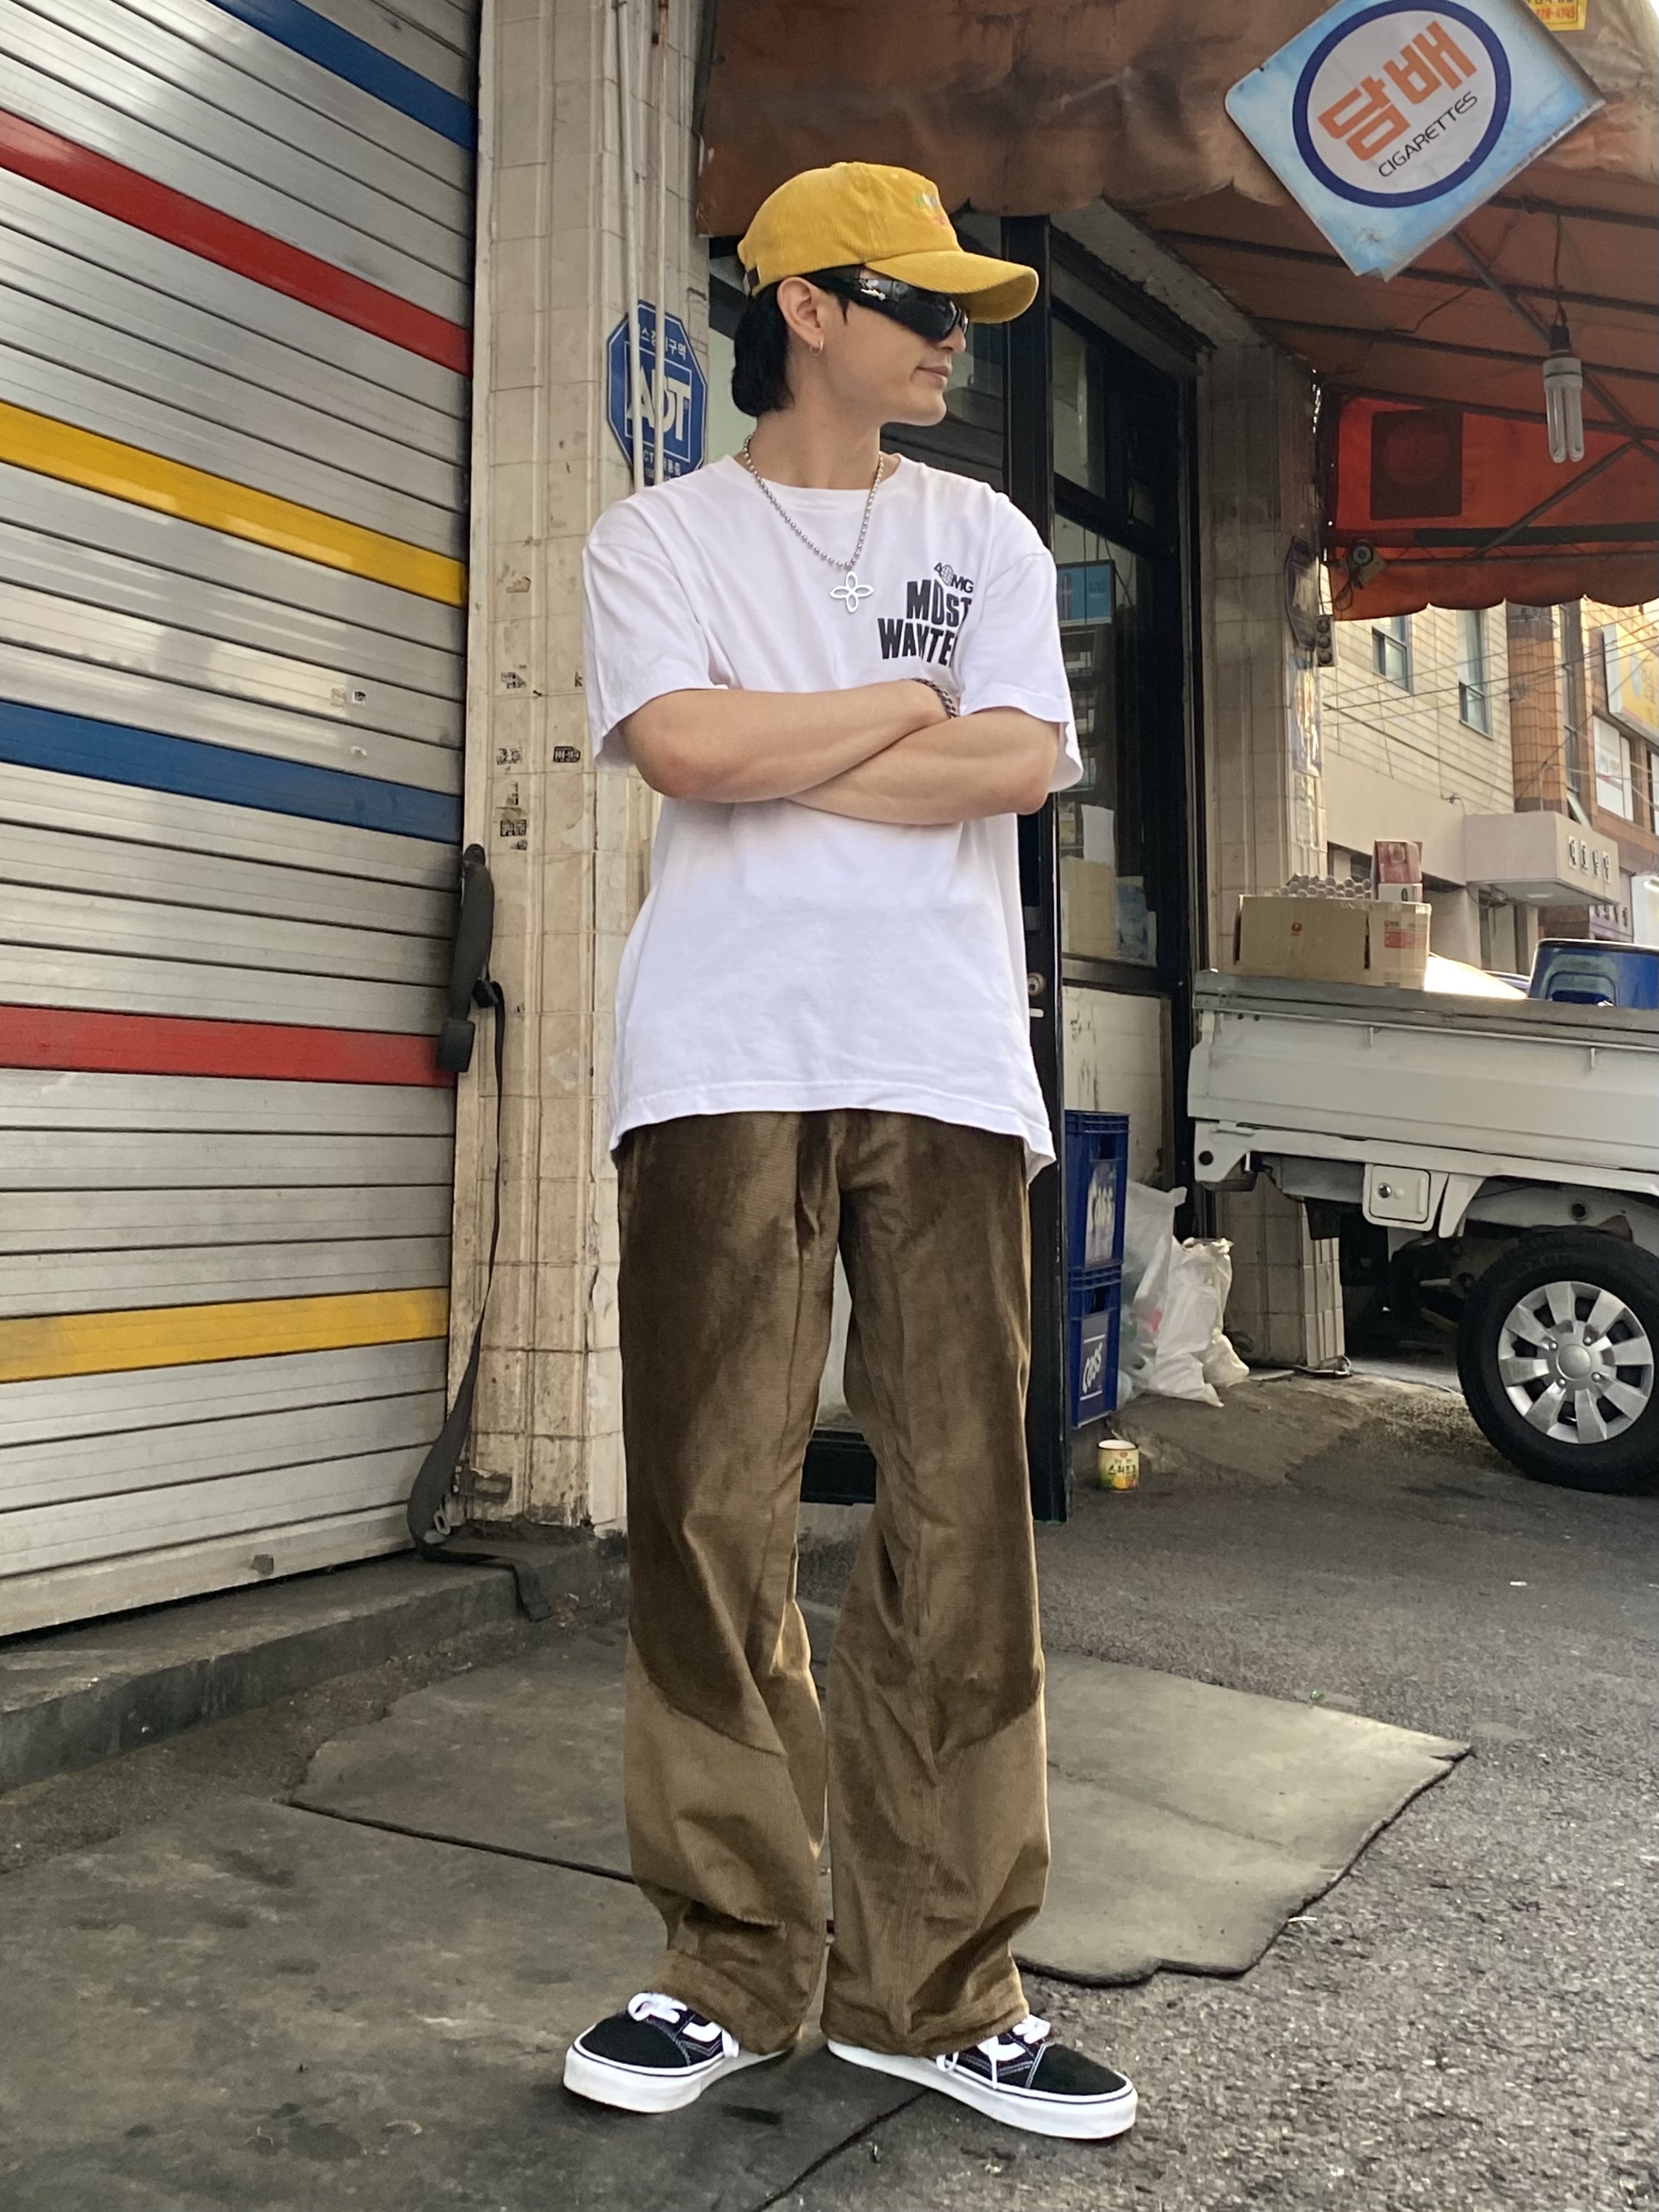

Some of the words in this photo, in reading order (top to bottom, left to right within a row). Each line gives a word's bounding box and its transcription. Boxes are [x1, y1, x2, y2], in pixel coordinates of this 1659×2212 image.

[1318, 20, 1477, 161] 담배
[1379, 91, 1478, 177] CIGARETTES
[626, 365, 690, 440] ADT
[906, 579, 972, 628] MOST
[877, 617, 957, 668] WANTE
